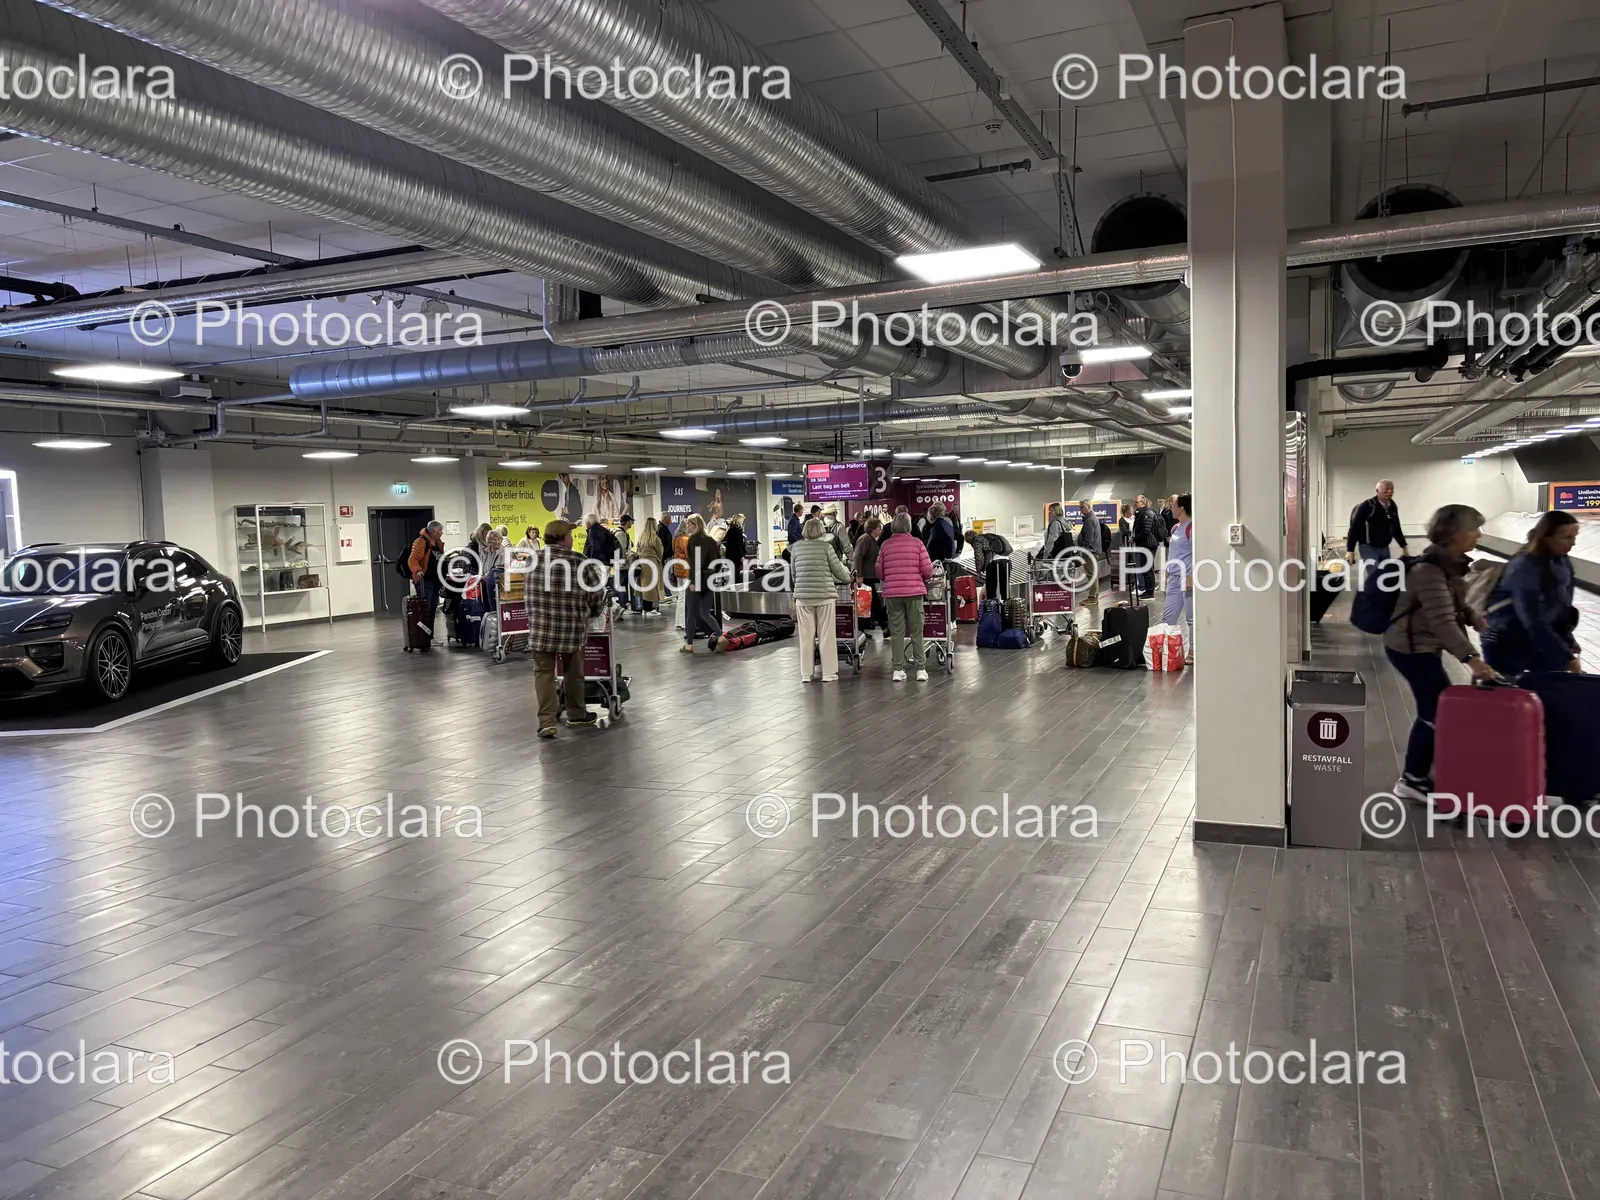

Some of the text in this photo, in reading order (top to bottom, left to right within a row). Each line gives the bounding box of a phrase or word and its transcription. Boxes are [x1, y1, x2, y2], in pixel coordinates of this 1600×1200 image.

[488, 477, 507, 487] Enten
[508, 478, 518, 487] det
[874, 466, 887, 493] 3
[488, 490, 503, 501] jobb
[504, 490, 518, 500] eller
[519, 490, 536, 501] fritid,
[673, 487, 684, 496] SAS
[489, 503, 514, 512] reis mer
[667, 504, 692, 513] JOURNEYS
[490, 514, 528, 525] behagelig til:
[1302, 754, 1353, 764] RESTAVFALL
[1313, 764, 1342, 773] WASTE
